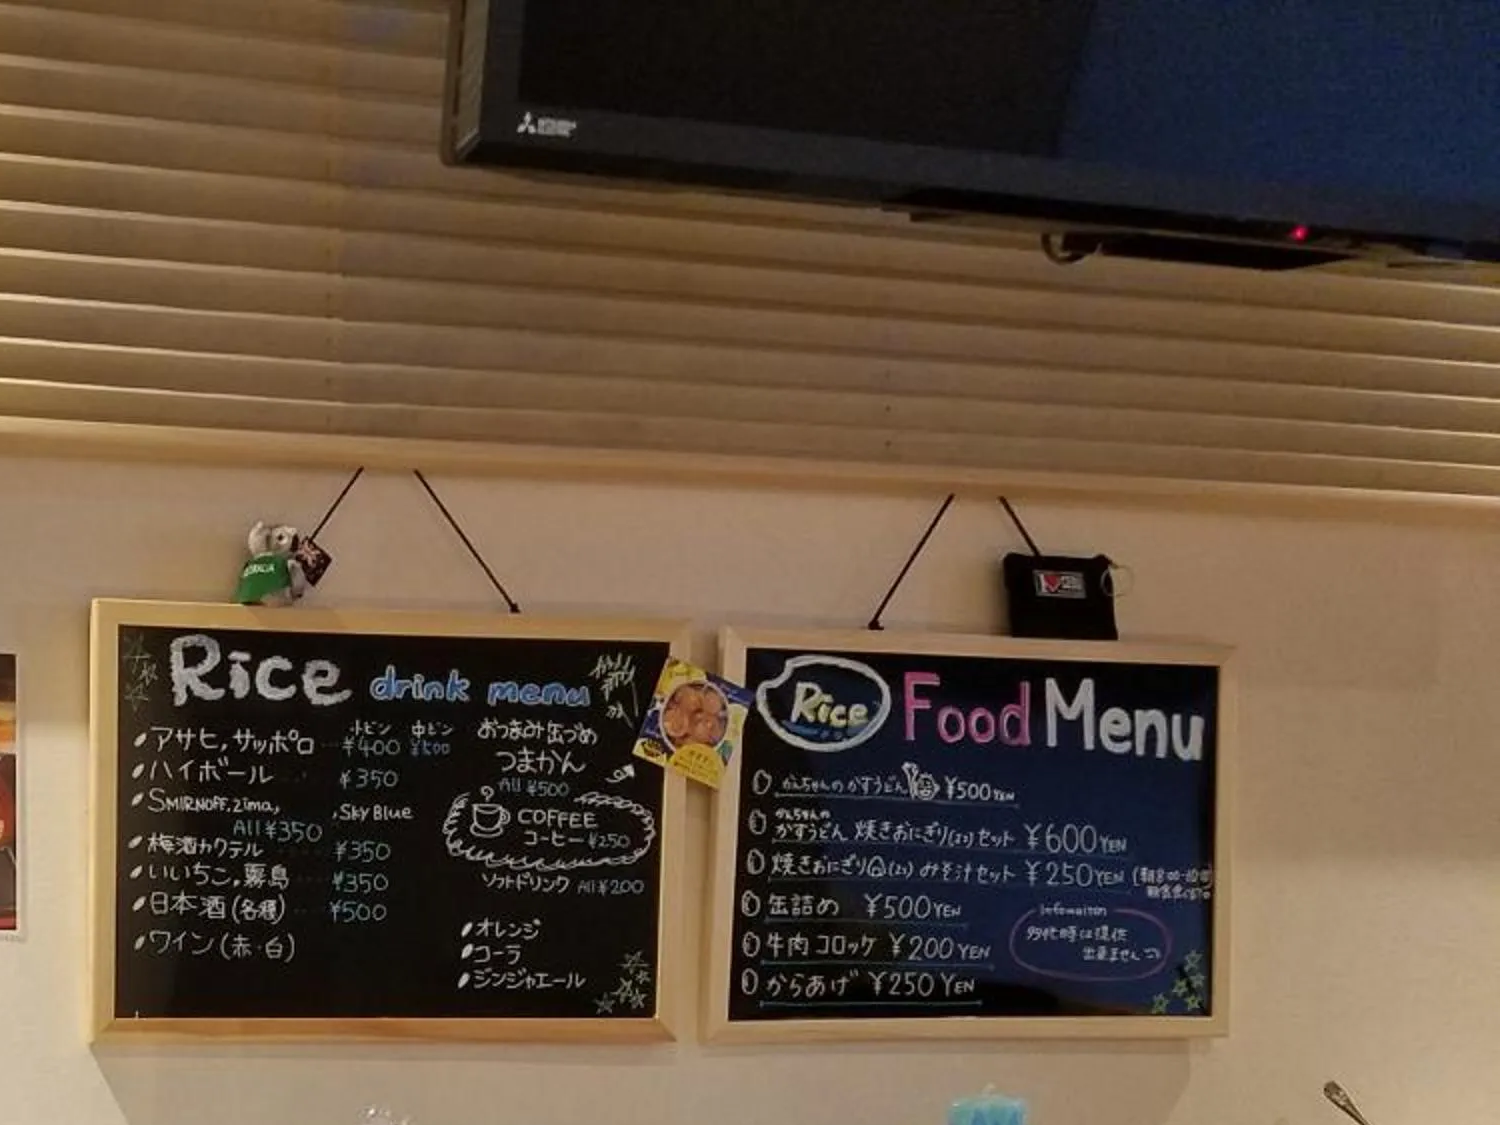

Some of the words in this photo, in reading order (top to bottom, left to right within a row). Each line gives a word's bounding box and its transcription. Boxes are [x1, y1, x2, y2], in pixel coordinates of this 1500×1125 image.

[170, 634, 353, 707] Rice
[369, 664, 471, 702] drink
[487, 681, 591, 707] menu
[790, 681, 869, 729] Rice
[903, 671, 1032, 747] Food
[1045, 677, 1206, 762] Menu
[342, 735, 401, 759] ¥400
[150, 756, 275, 786] ハイボール
[495, 746, 587, 774] つまかん
[339, 768, 400, 790] ¥350
[373, 803, 414, 822] Blue
[517, 807, 598, 829] COFFEE
[265, 820, 324, 843] ¥350
[523, 830, 585, 847] コーヒー
[588, 831, 631, 850] ¥250
[147, 832, 264, 859] 梅酒カクテル
[334, 840, 393, 863] ¥350
[331, 871, 390, 894] ¥350
[481, 871, 570, 893] ソフトドリンク
[329, 900, 388, 923] ¥500
[768, 894, 840, 917] 缶詰め
[475, 917, 542, 941] オレンジ
[473, 944, 522, 965] コーラ
[888, 931, 953, 961] ¥200
[957, 943, 992, 960] YEN
[472, 966, 587, 990] ジンジャエール
[766, 967, 860, 998] からあげ
[867, 970, 935, 997] ¥250
[939, 972, 976, 997] YEN
